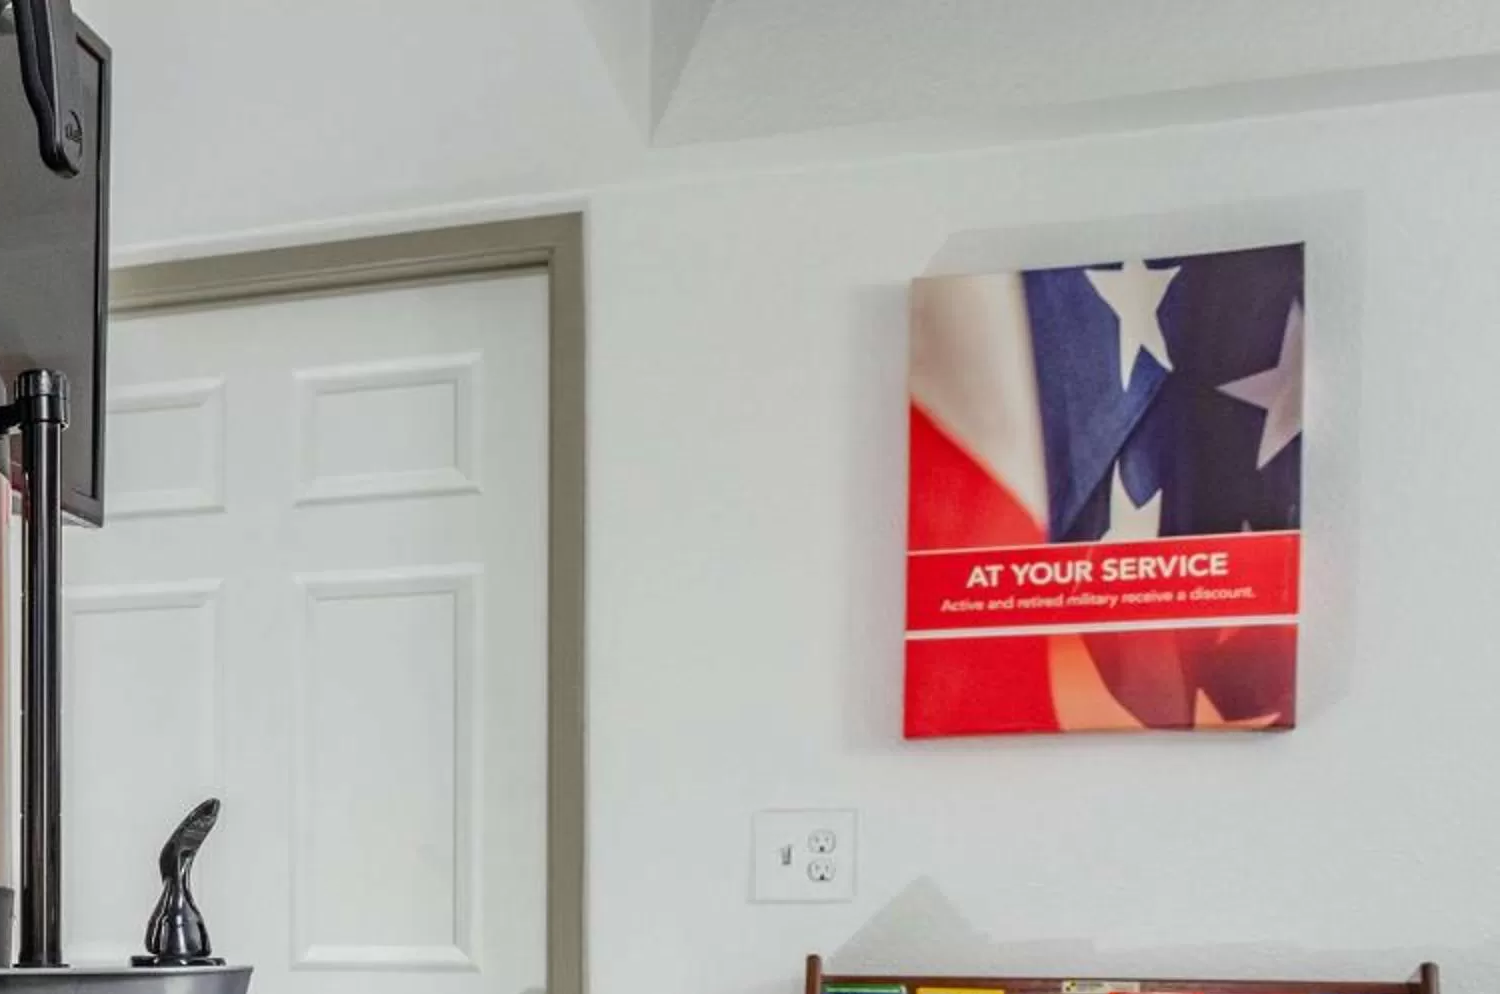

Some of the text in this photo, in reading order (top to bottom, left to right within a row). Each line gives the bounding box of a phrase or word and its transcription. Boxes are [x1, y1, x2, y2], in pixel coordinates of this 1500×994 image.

[966, 551, 1229, 589] AT YOUR SERVICE
[940, 599, 985, 612] Active
[988, 596, 1015, 610] and
[1017, 593, 1064, 609] retired
[1066, 592, 1119, 609] military
[1121, 589, 1173, 604] receive
[1176, 590, 1188, 601] a
